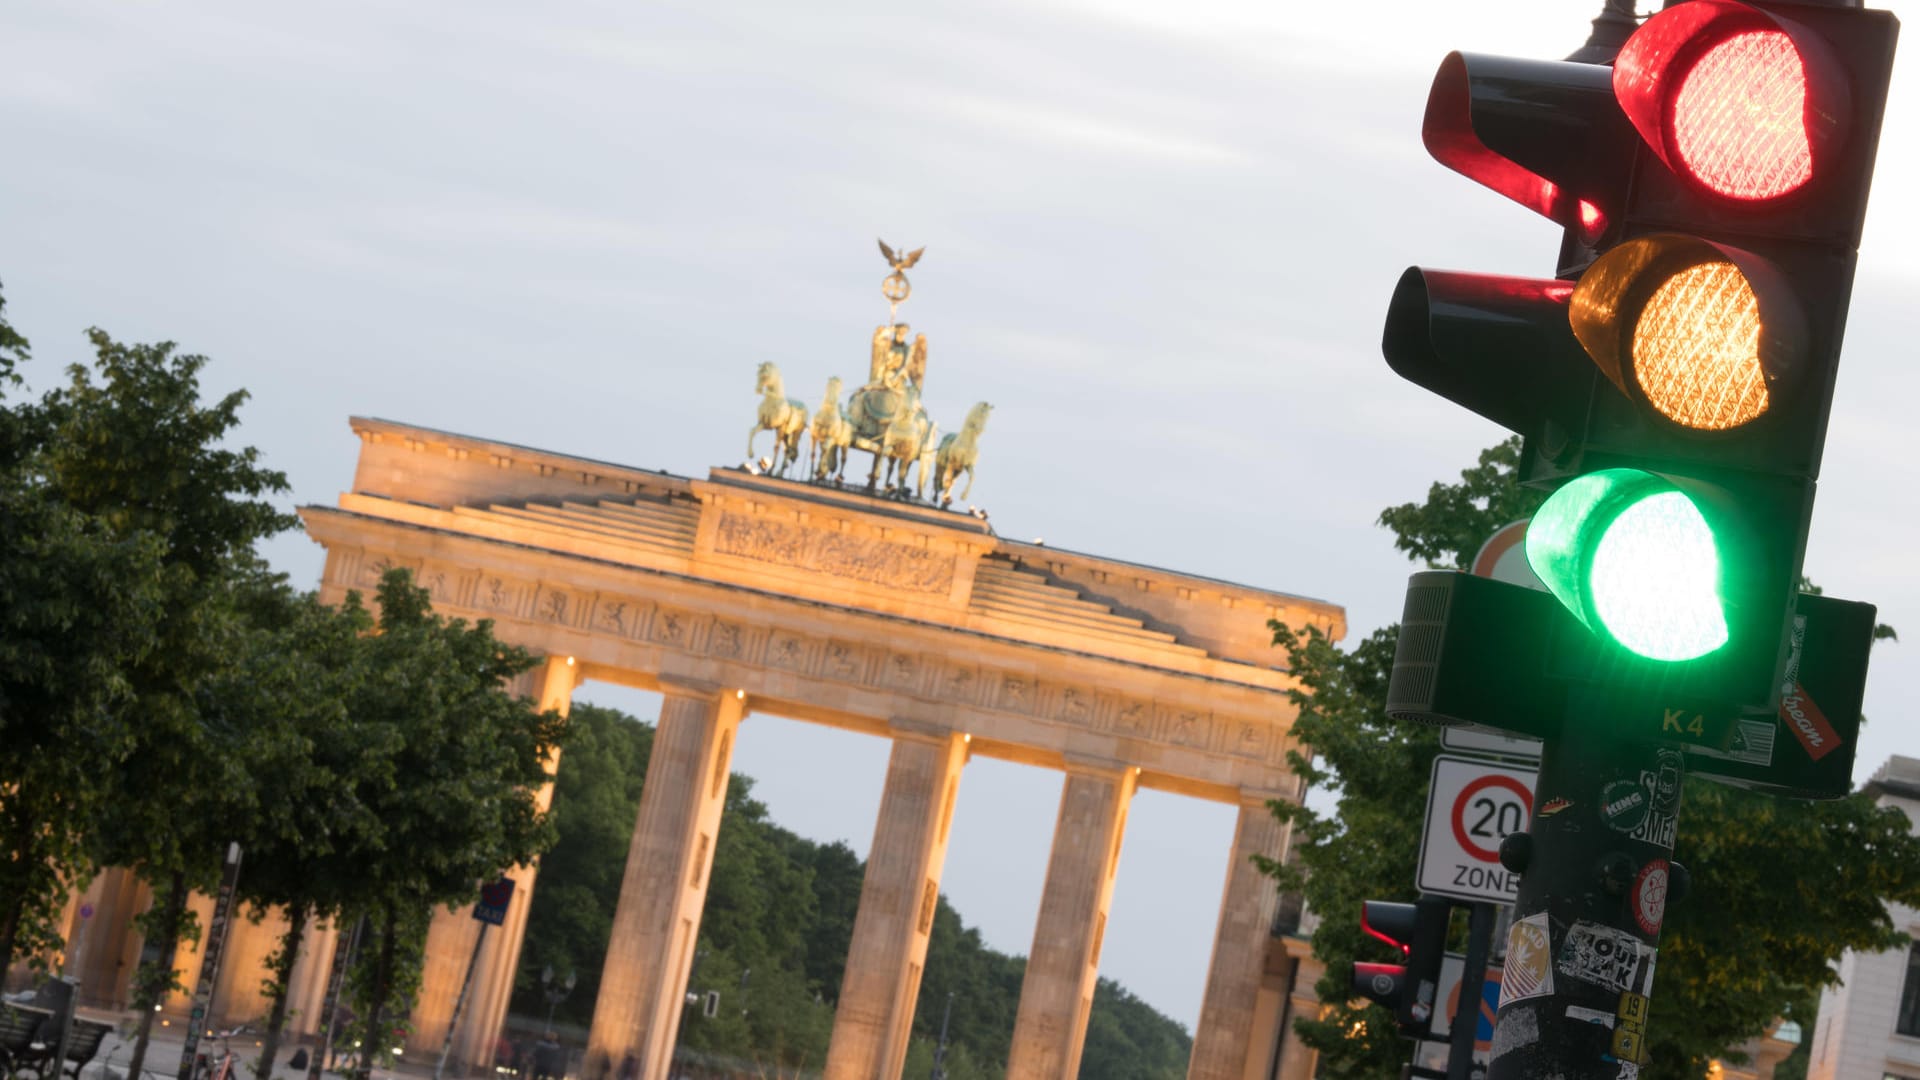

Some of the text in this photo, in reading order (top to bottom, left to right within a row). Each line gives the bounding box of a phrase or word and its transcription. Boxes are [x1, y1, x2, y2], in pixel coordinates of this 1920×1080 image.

[1663, 707, 1704, 737] K4
[1470, 797, 1522, 838] 20
[1453, 864, 1521, 894] ZONE
[1626, 996, 1640, 1017] 19
